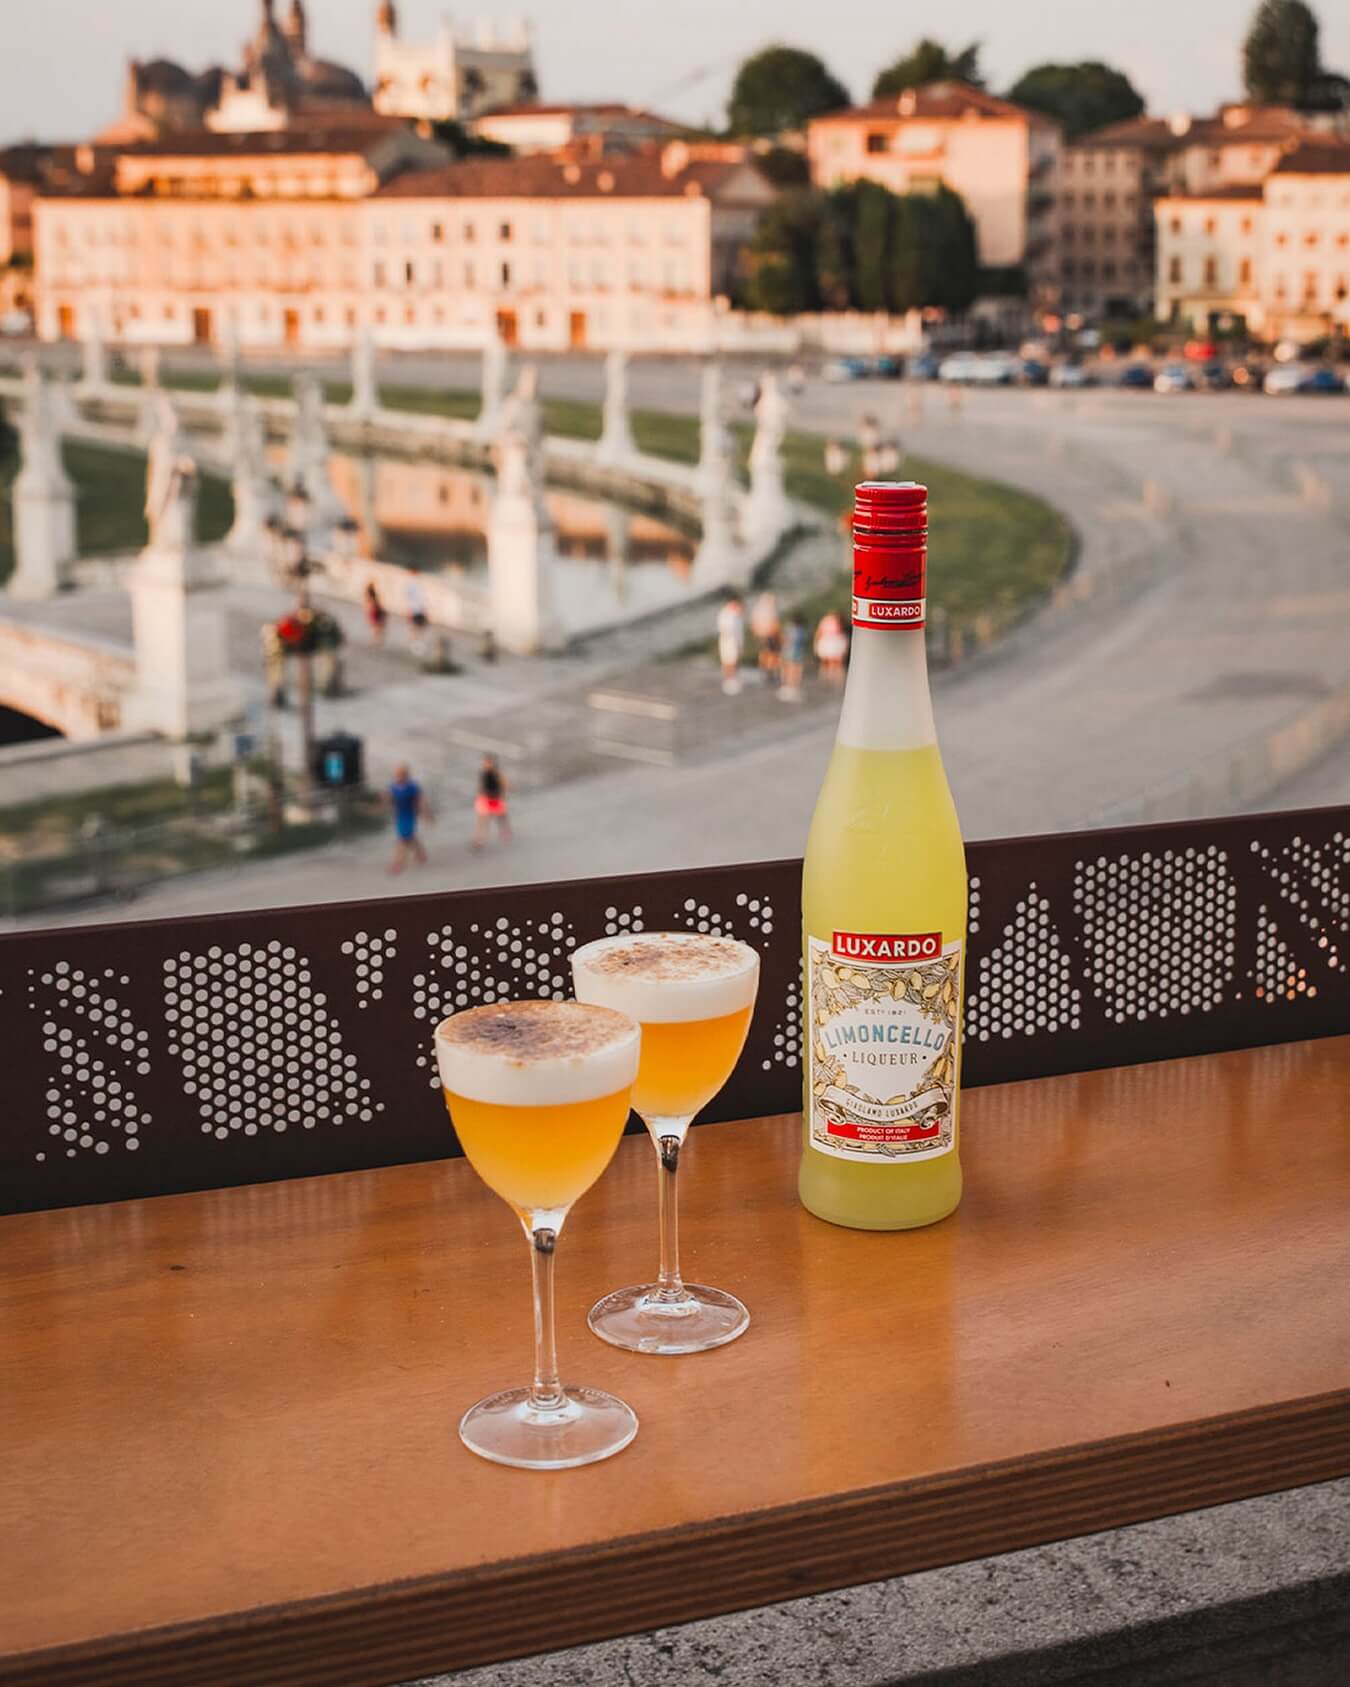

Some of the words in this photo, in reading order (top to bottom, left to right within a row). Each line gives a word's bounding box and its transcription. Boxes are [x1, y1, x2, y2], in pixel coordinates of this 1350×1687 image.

[871, 606, 921, 617] LUXARDO
[836, 935, 937, 957] LUXARDO
[824, 1024, 945, 1051] LIMONCELLO
[852, 1051, 918, 1066] LIQUEUR
